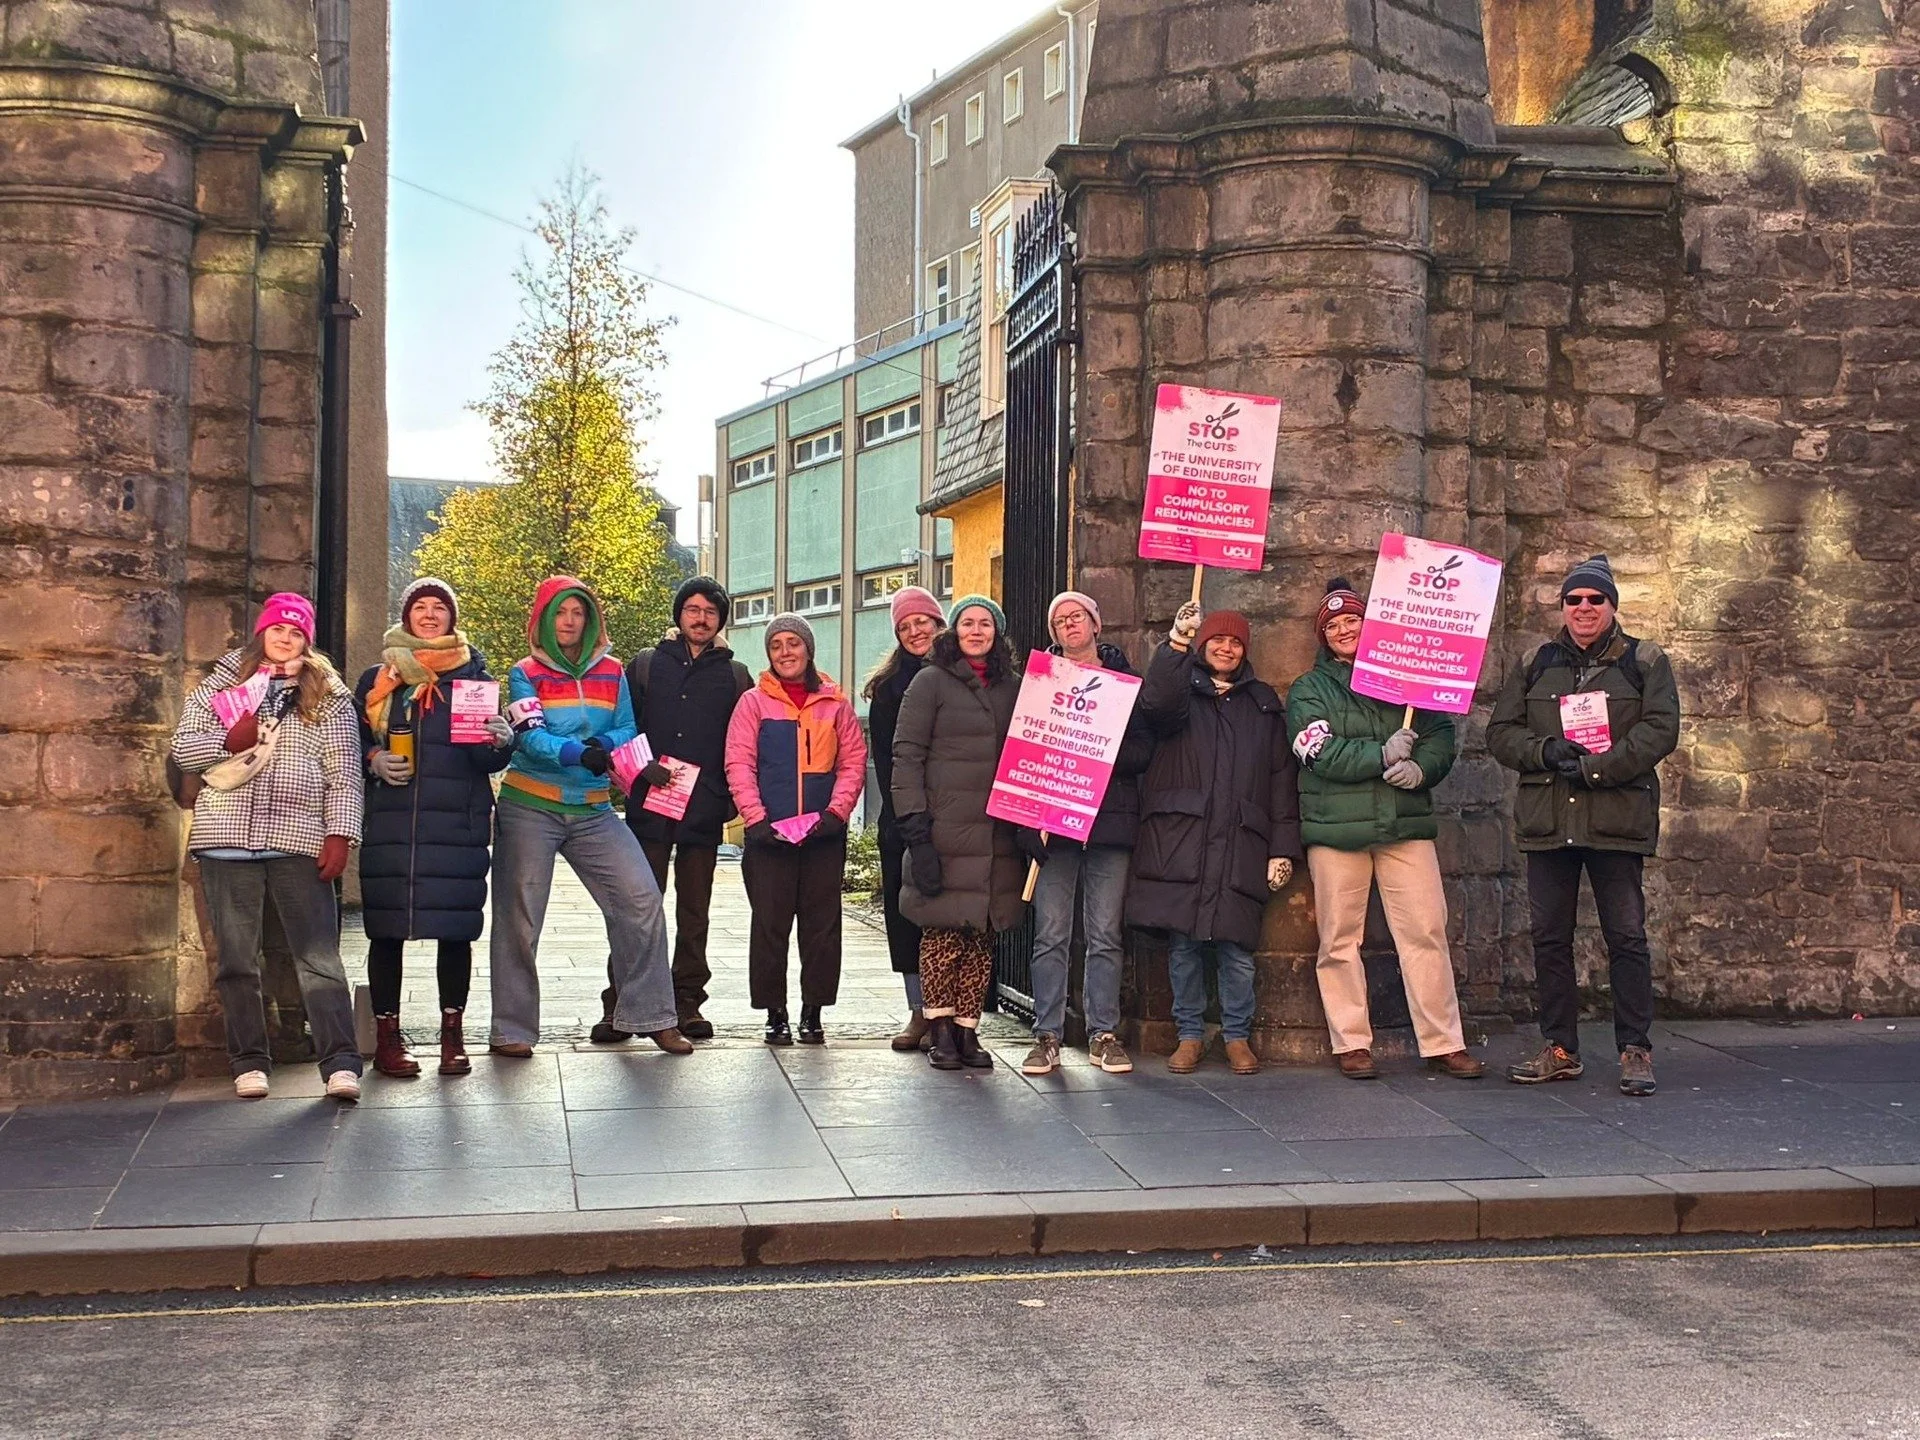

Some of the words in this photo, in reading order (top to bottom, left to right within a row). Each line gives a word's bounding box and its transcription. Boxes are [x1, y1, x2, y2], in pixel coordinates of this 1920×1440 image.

[1189, 422, 1239, 440] STOP
[1187, 439, 1202, 448] The
[1204, 441, 1237, 452] CUTS:
[1162, 451, 1185, 462] THE
[1189, 454, 1262, 471] UNIVERSITY
[1163, 464, 1179, 474] OF
[1183, 467, 1257, 484] EDINBURGH
[1188, 485, 1207, 496] NO
[1210, 488, 1227, 499] TO
[1163, 495, 1250, 514] COMPULSORY
[1155, 507, 1254, 528] REDUNDANCIES!
[1223, 545, 1252, 558] UCU
[1409, 572, 1460, 590] STOP
[1406, 588, 1422, 597] The
[1424, 591, 1457, 601] CUTS:
[281, 609, 306, 624] UCU
[1380, 598, 1404, 610] THE
[1407, 603, 1480, 622] UNIVERSITY
[1380, 611, 1397, 620] OF
[1400, 614, 1474, 633] EDINBURGH
[1404, 632, 1422, 644] NO
[1426, 635, 1443, 646] TO
[1377, 640, 1464, 662] COMPULSORY
[1368, 650, 1468, 675] REDUNDANCIES!
[1053, 691, 1098, 712] STOP
[1433, 691, 1462, 703] UCU
[520, 701, 543, 713] UC
[1050, 707, 1065, 718] The
[1066, 712, 1093, 724] CUTS:
[1023, 715, 1047, 729] THE
[1049, 723, 1112, 747] UNIVERSITY
[1299, 724, 1331, 746] UCU
[1022, 729, 1040, 740] OF
[1042, 735, 1105, 758] EDINBURGH
[1044, 752, 1062, 765] NO
[1064, 757, 1077, 769] TO
[1018, 758, 1093, 787] COMPULSORY
[1008, 770, 1095, 801] REDUNDANCIES!
[1062, 815, 1085, 829] UCU
